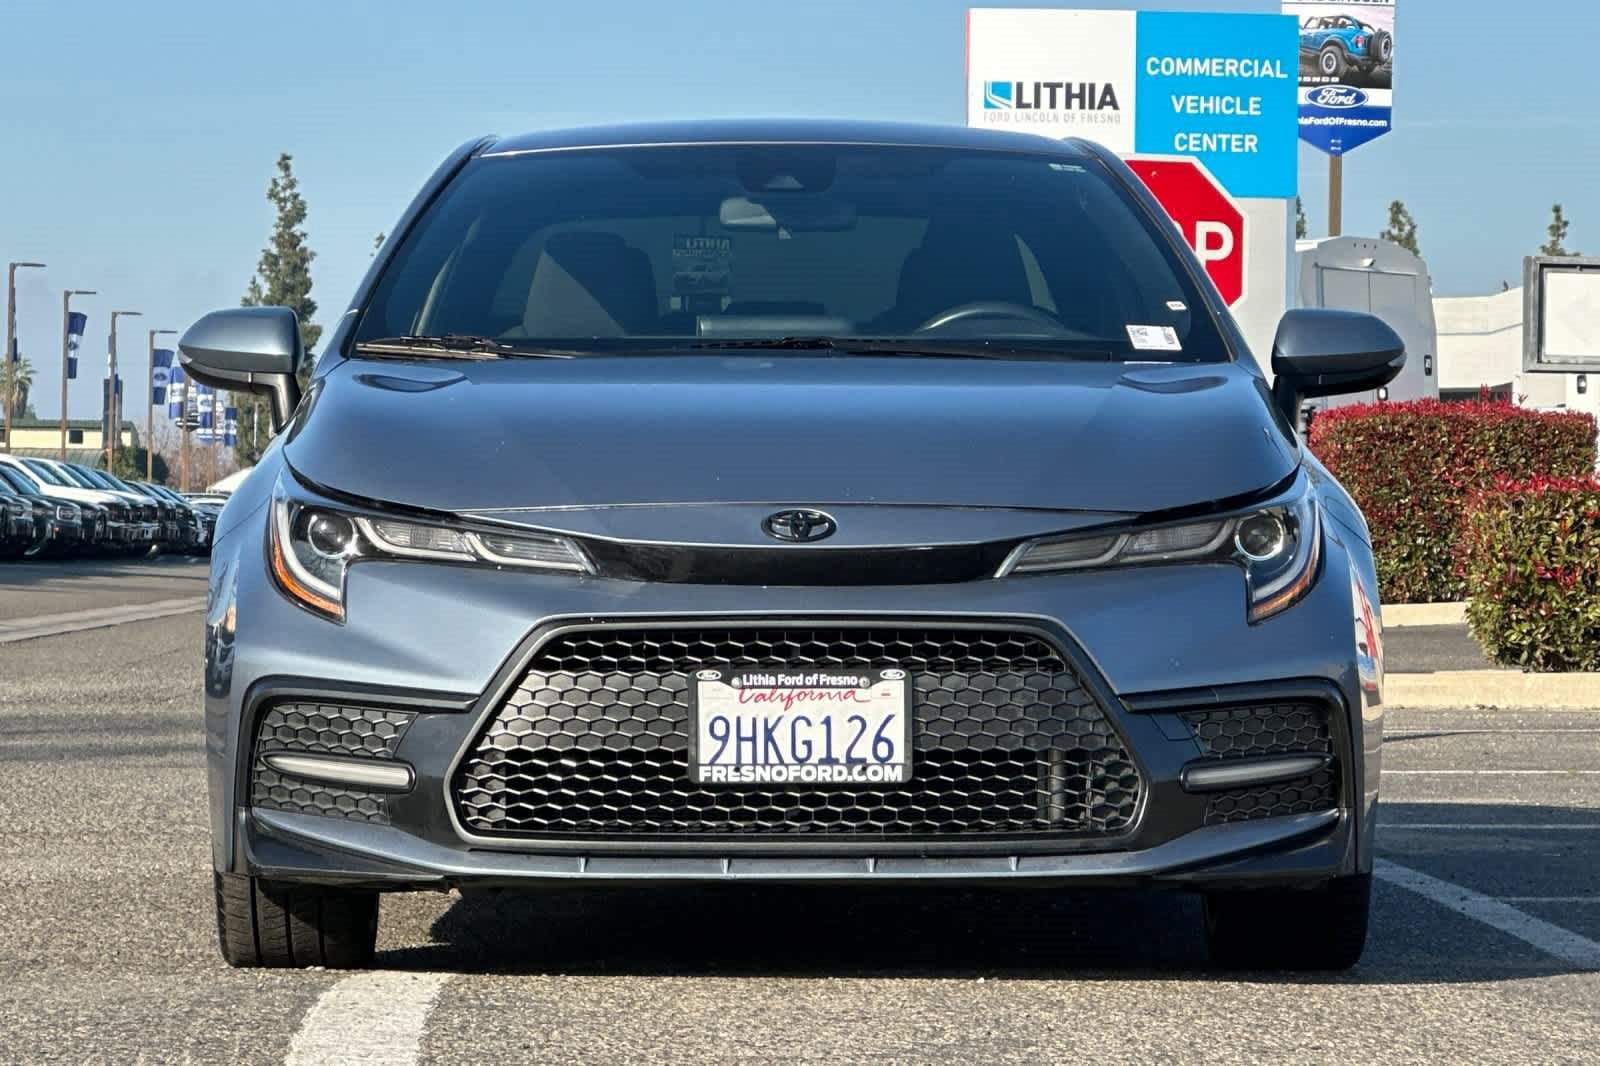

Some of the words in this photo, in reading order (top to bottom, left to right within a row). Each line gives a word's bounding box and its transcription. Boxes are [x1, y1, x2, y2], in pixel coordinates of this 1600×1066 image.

[1146, 56, 1288, 79] COMMERCIAL
[1015, 81, 1120, 111] LITHIA
[1171, 94, 1262, 116] VEHICLE
[1316, 87, 1358, 105] Ford
[983, 111, 1010, 123] FORD
[1014, 111, 1059, 123] LINCOLN
[1063, 112, 1077, 124] OF
[1081, 112, 1121, 125] FRESNO
[1174, 132, 1258, 152] CENTER
[742, 673, 776, 686] Lithia
[777, 673, 804, 686] Ford
[805, 673, 818, 686] of
[819, 674, 859, 686] Fresno
[738, 687, 872, 711] California
[709, 714, 895, 764] 9HKG126
[699, 765, 903, 782] FRESNOFORD.COM
